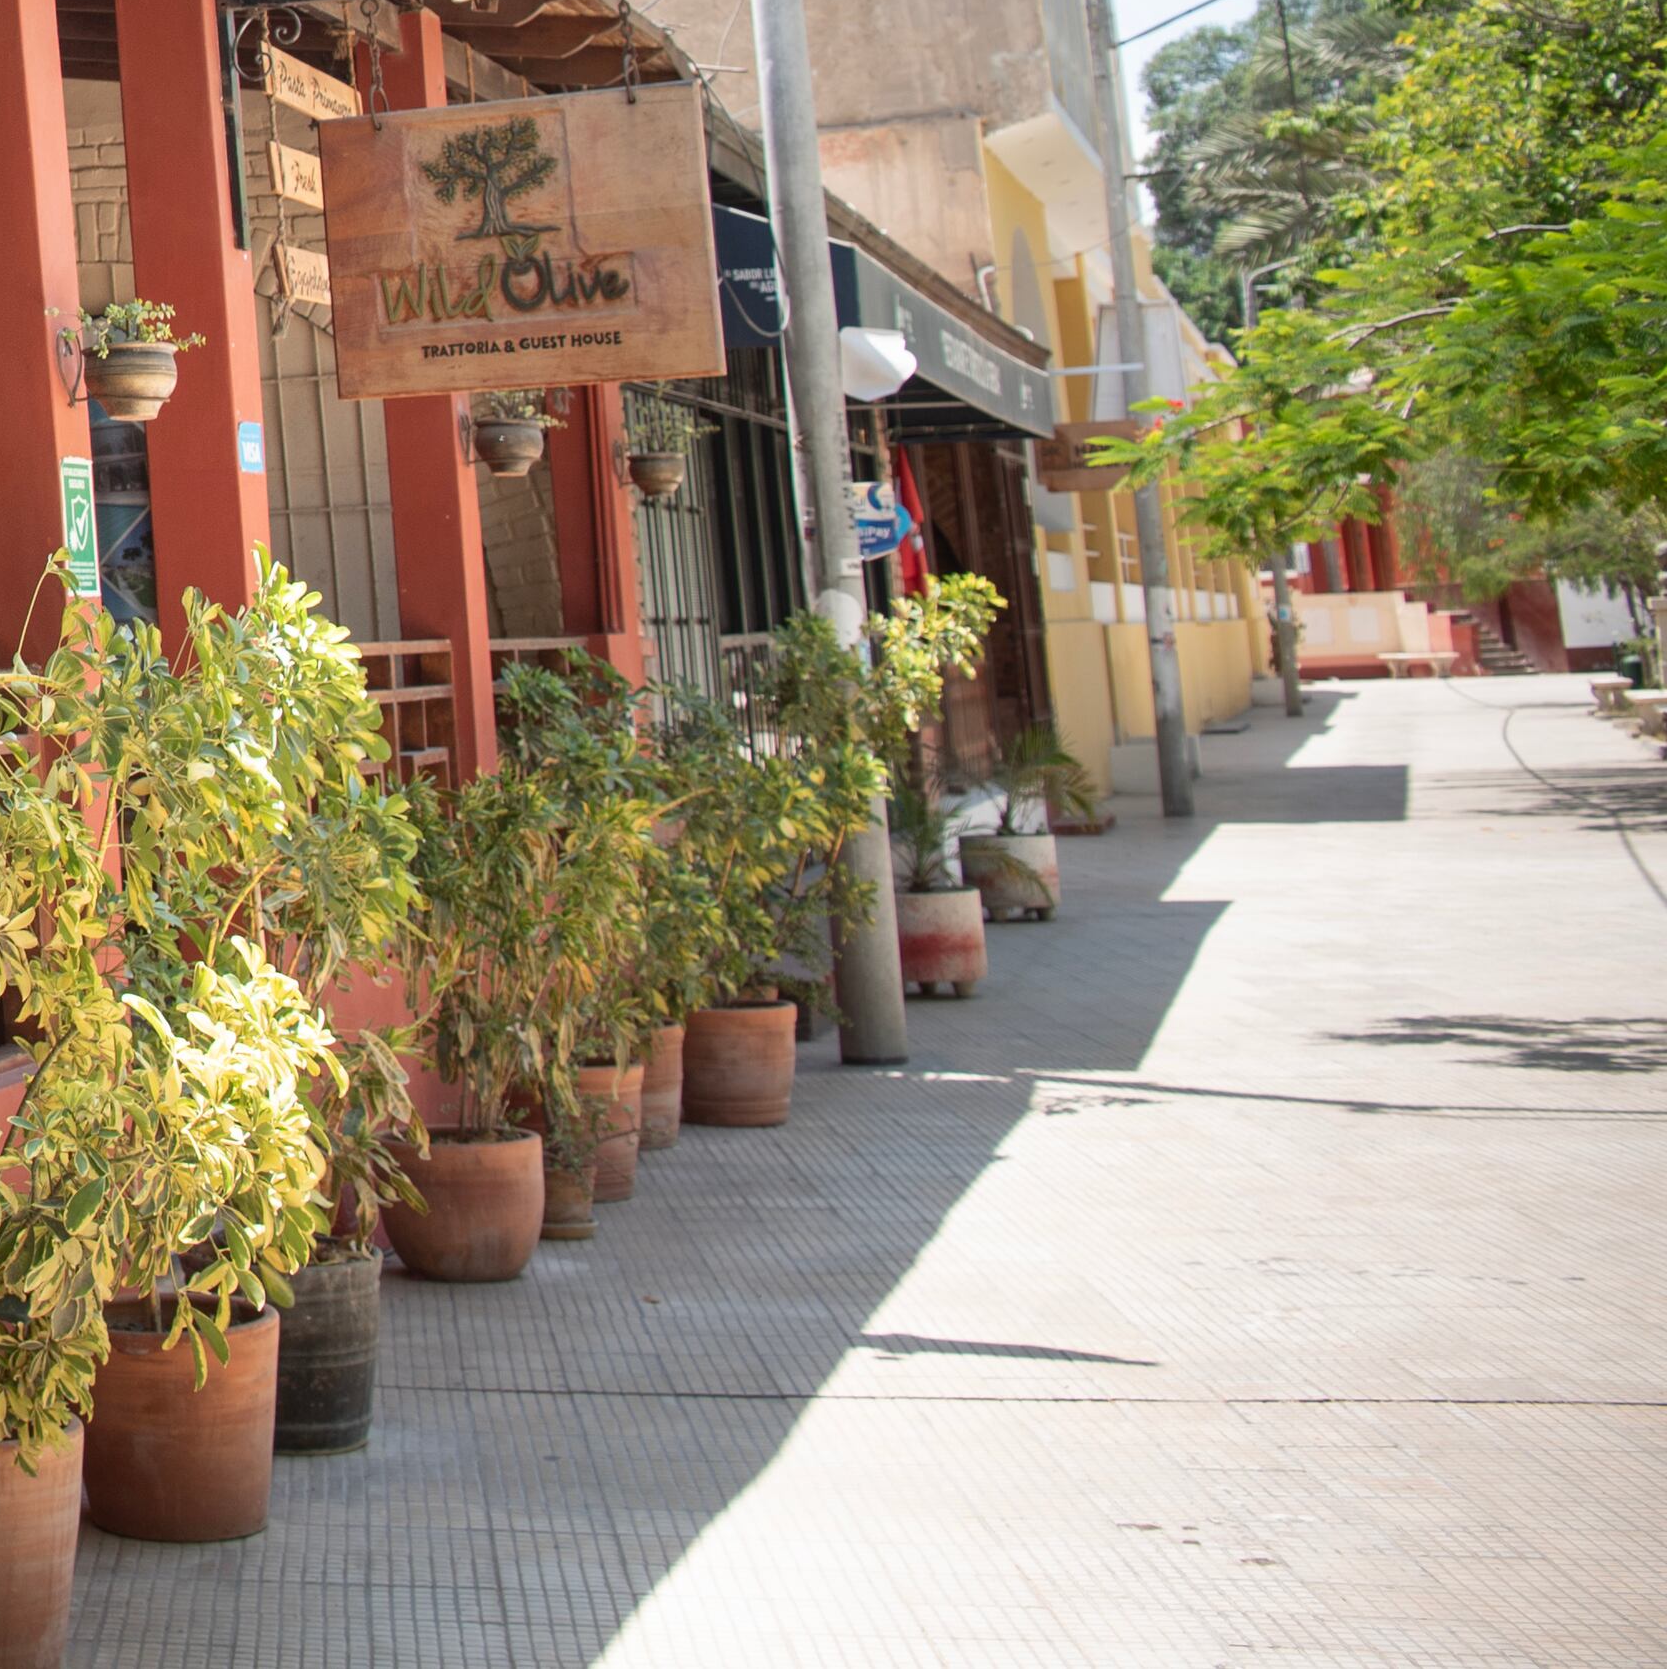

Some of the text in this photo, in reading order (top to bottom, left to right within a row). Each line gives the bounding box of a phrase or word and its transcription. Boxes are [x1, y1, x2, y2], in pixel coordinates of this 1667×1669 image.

[381, 249, 630, 324] Wild Olive
[420, 331, 623, 359] TRATTORIA & GUEST HOUSE
[241, 442, 261, 463] VISA
